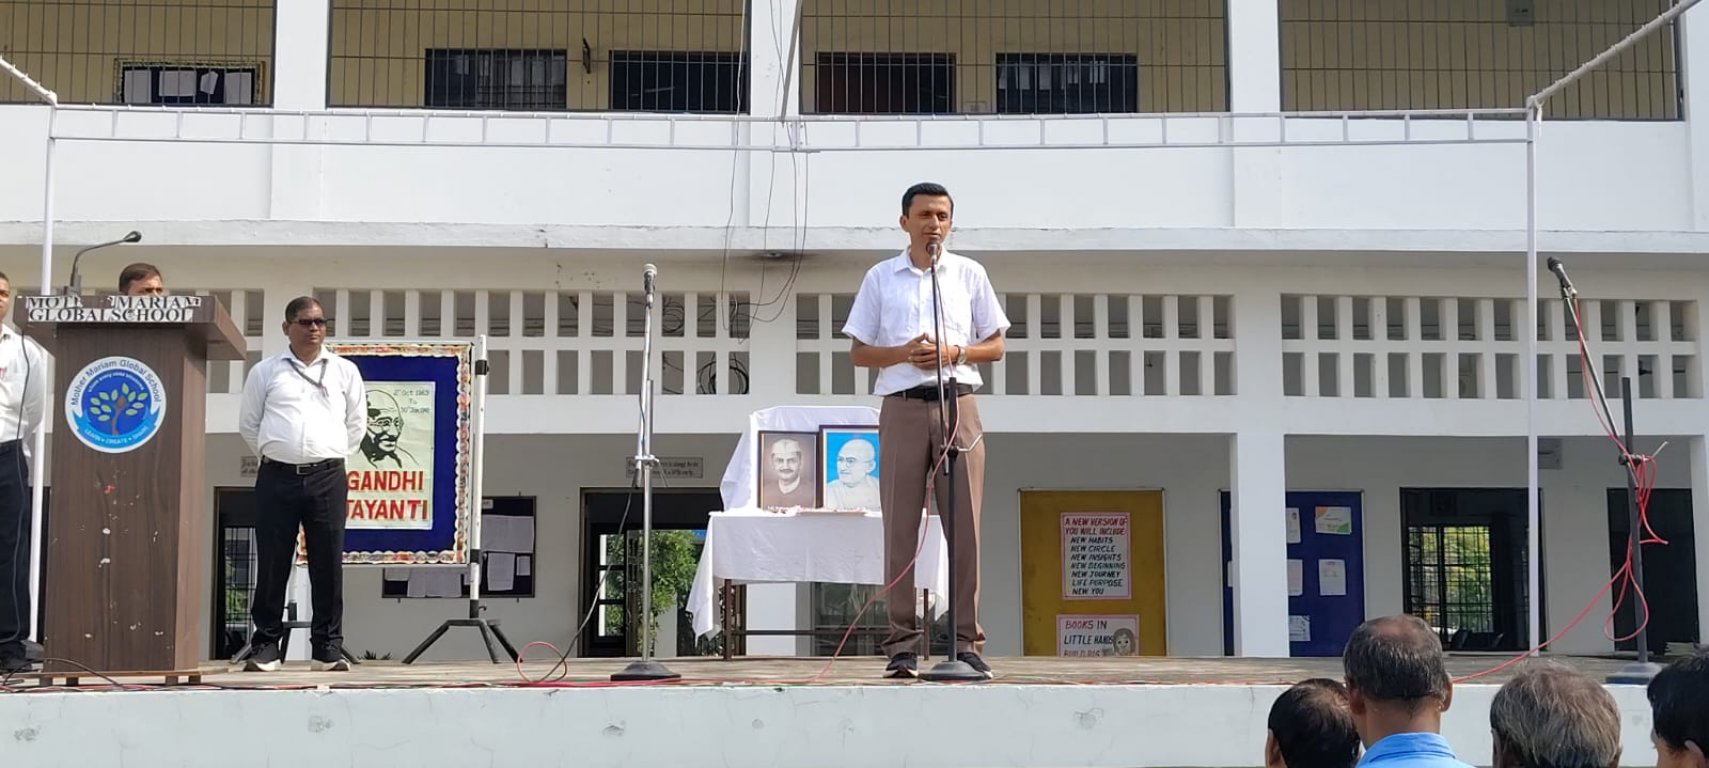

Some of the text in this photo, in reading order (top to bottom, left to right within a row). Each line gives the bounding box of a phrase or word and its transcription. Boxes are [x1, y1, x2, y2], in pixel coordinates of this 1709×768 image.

[29, 309, 190, 321] GLOBAL SCHOOL
[71, 377, 87, 405] Mother
[86, 360, 117, 377] Mariam
[120, 359, 147, 375] Global
[145, 373, 162, 402] School
[347, 470, 424, 491] GANDHI
[1065, 518, 1070, 526] A
[1072, 518, 1087, 526] NEW
[1091, 518, 1118, 526] VERSION
[1066, 527, 1078, 535] YOU
[1080, 527, 1097, 535] WILL
[1071, 536, 1113, 544] NEW HABITS
[1088, 545, 1115, 553] CIRCLE
[1071, 553, 1121, 561] NEW INSIGHTS
[1089, 579, 1123, 587] PURPOSE
[1065, 620, 1108, 630] BOOKS IN
[1064, 635, 1092, 645] LITTLE
